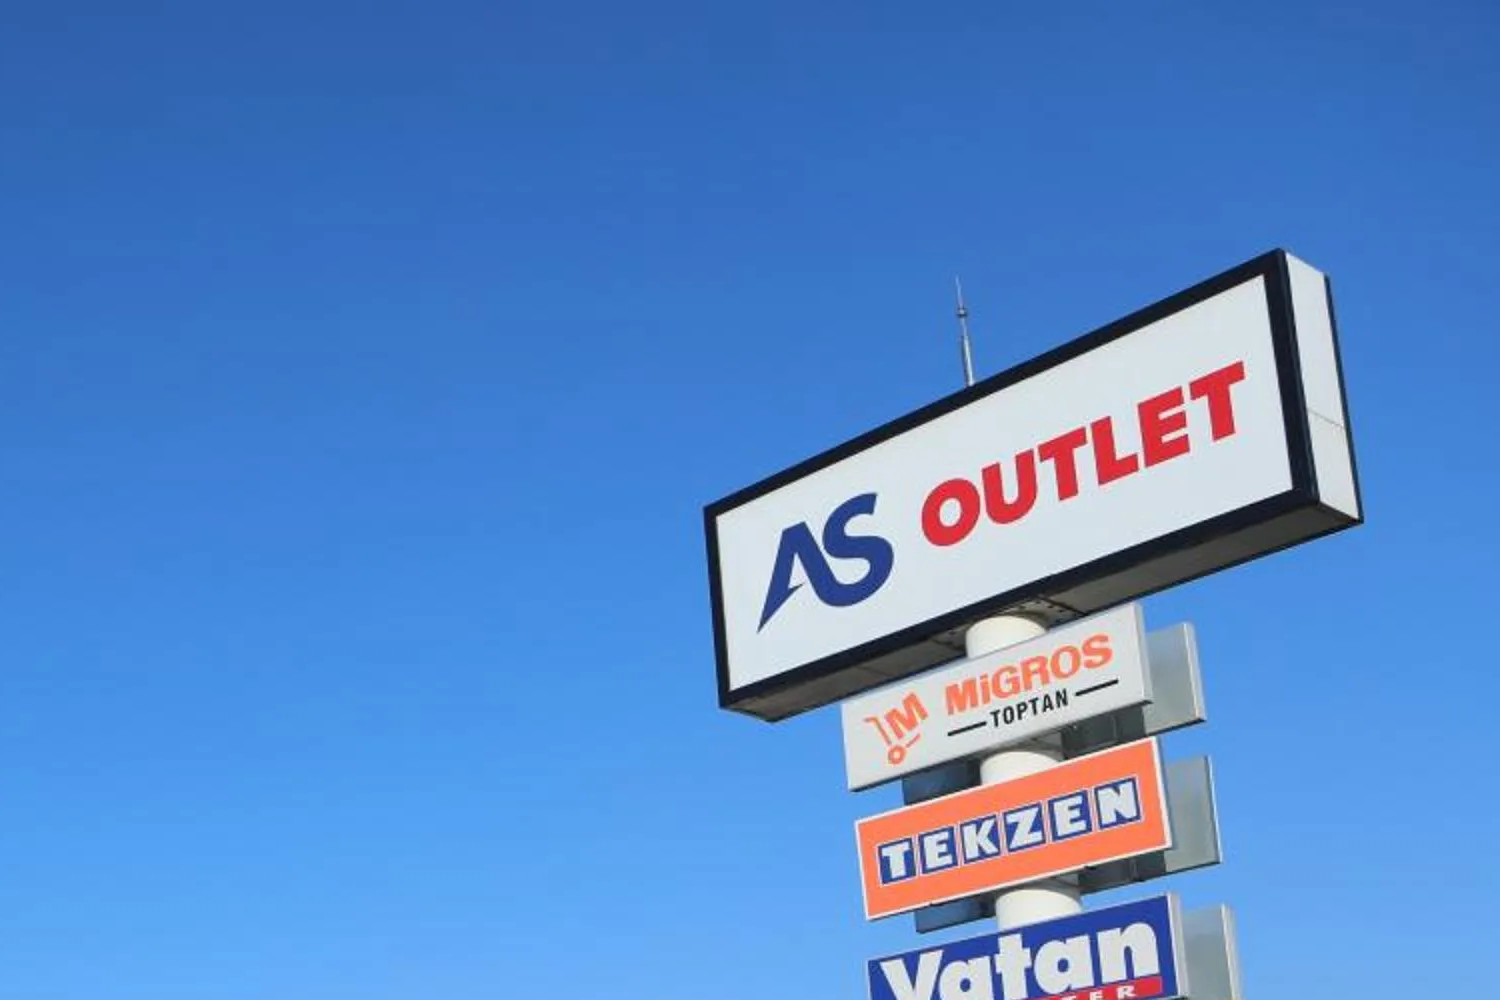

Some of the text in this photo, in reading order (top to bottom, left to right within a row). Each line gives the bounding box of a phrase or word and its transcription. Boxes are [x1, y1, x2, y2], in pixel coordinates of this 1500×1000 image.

[757, 361, 1245, 634] AS OUTLET
[990, 688, 1069, 728] TOPTAN
[881, 778, 1141, 880] TEKZEN
